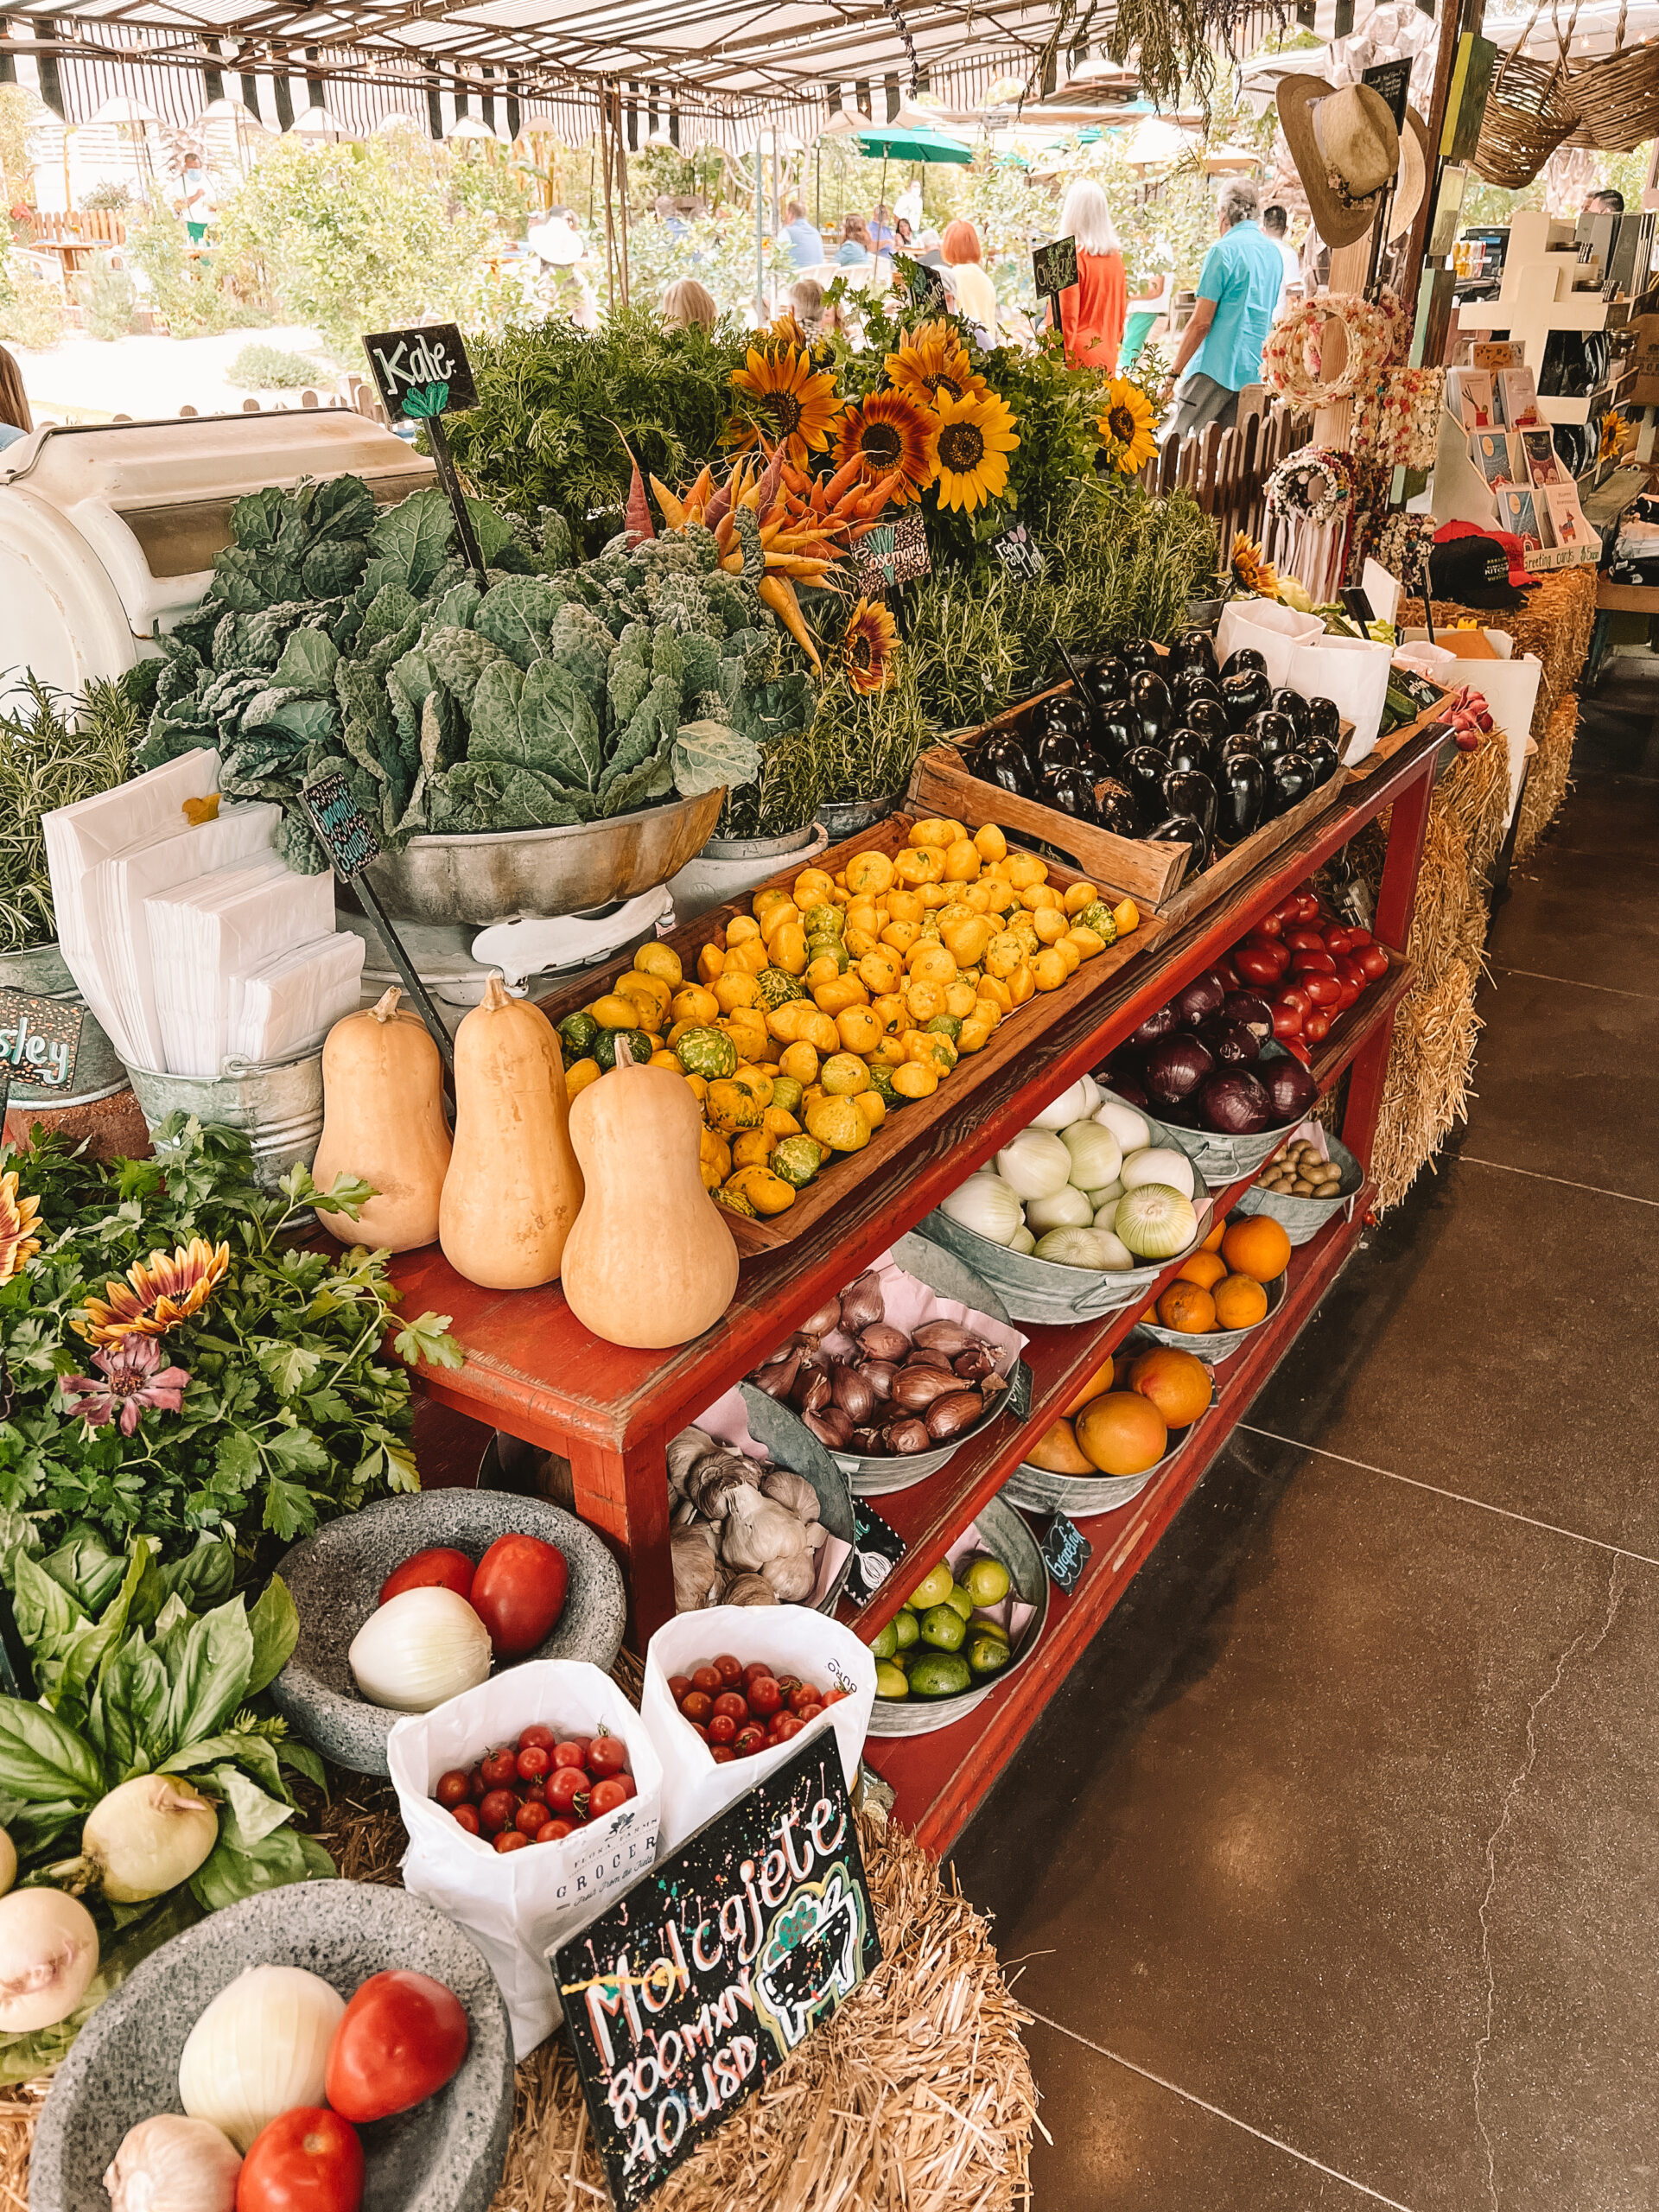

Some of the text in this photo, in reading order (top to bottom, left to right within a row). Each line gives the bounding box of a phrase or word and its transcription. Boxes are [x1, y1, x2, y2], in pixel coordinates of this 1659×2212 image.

[334, 823, 376, 872] Squash
[0, 1017, 68, 1084] sley
[1046, 1521, 1085, 1577] Grapefruit
[585, 1797, 847, 2068] Molcajete
